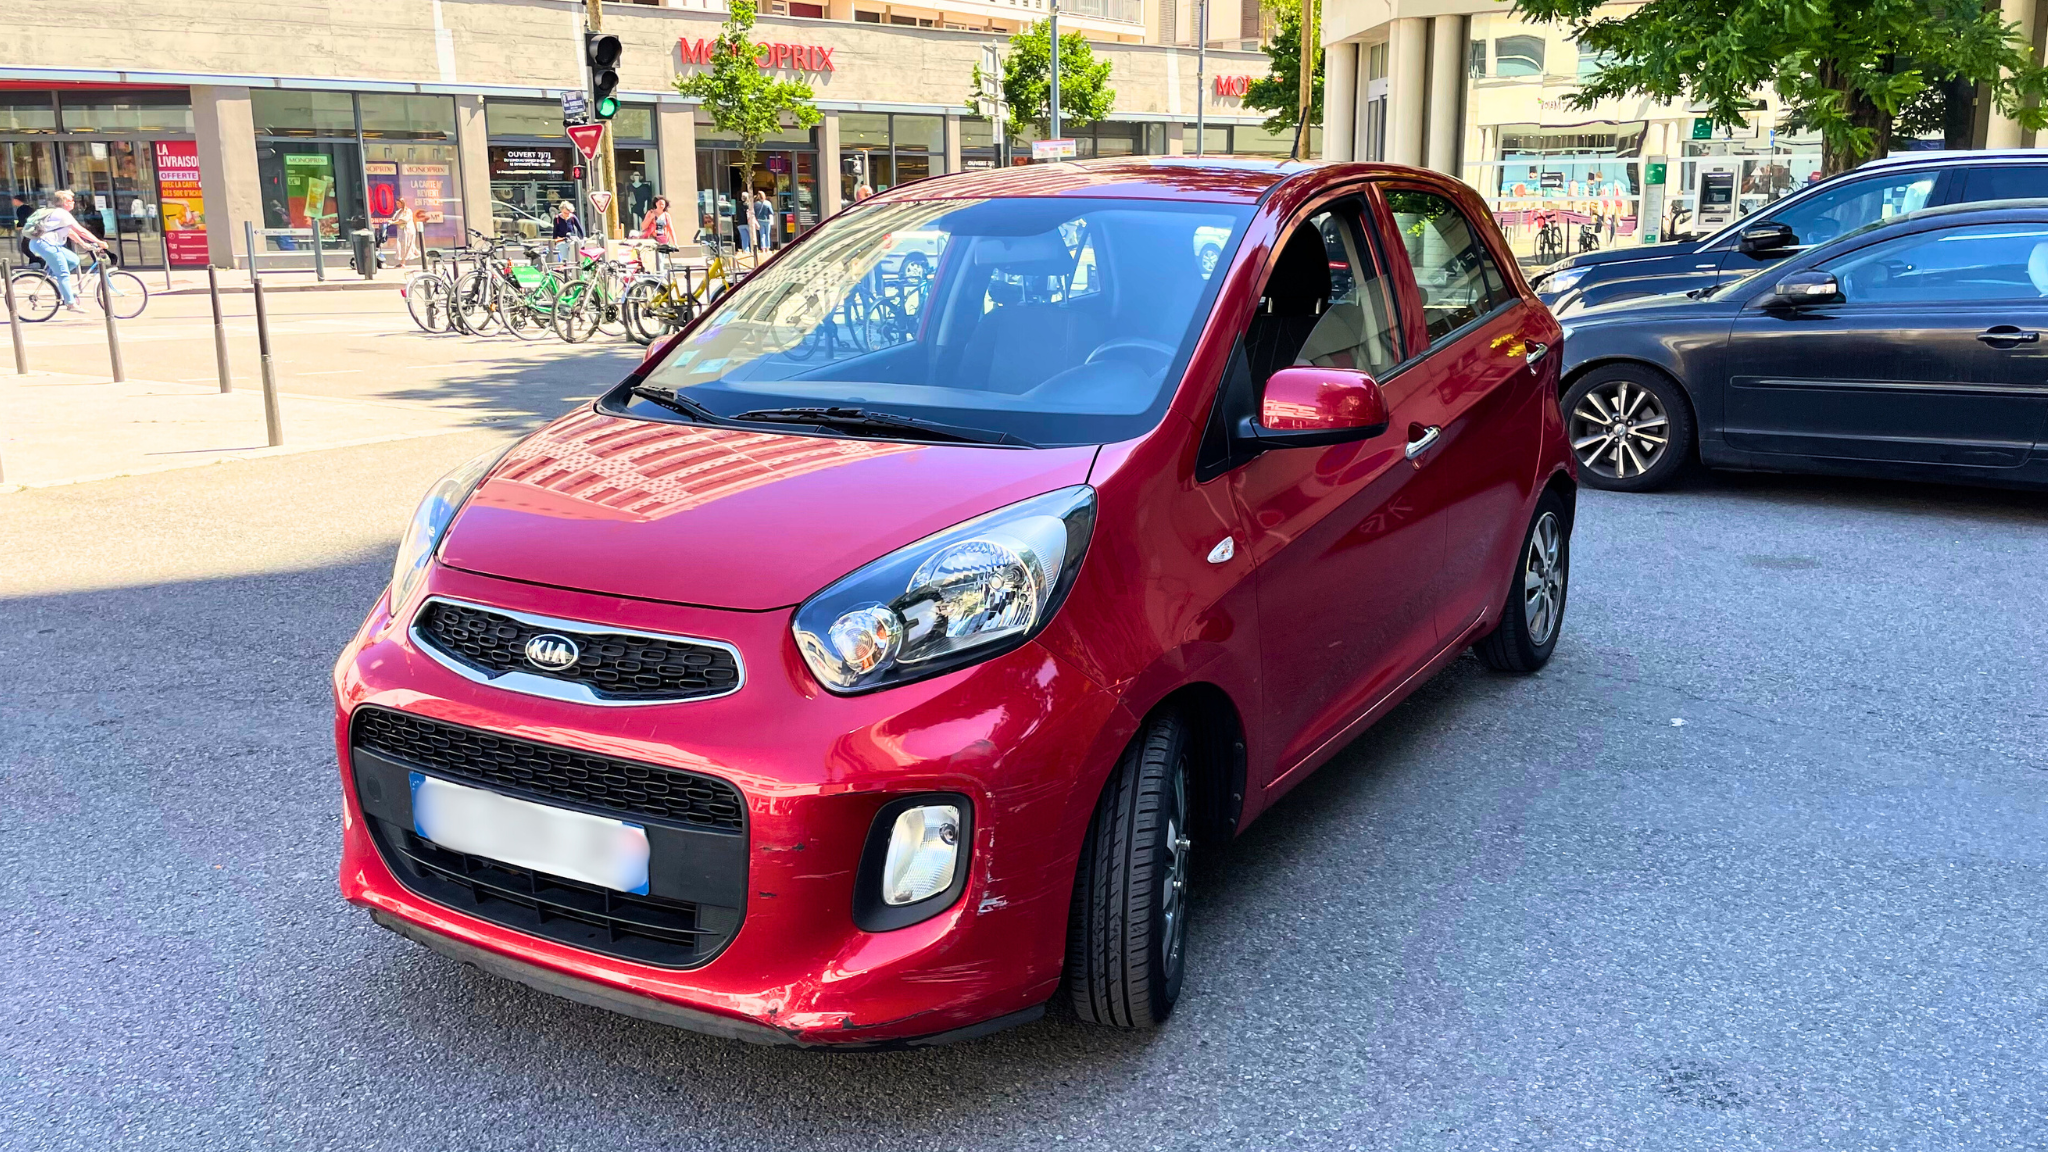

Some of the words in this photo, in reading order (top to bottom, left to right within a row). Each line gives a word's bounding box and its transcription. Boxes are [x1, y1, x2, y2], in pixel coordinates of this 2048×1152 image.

[679, 37, 836, 72] MOPRIX
[156, 144, 169, 155] LA
[158, 156, 200, 167] LIVRAISO
[160, 172, 198, 180] OFFERTE
[531, 639, 566, 664] KIA
